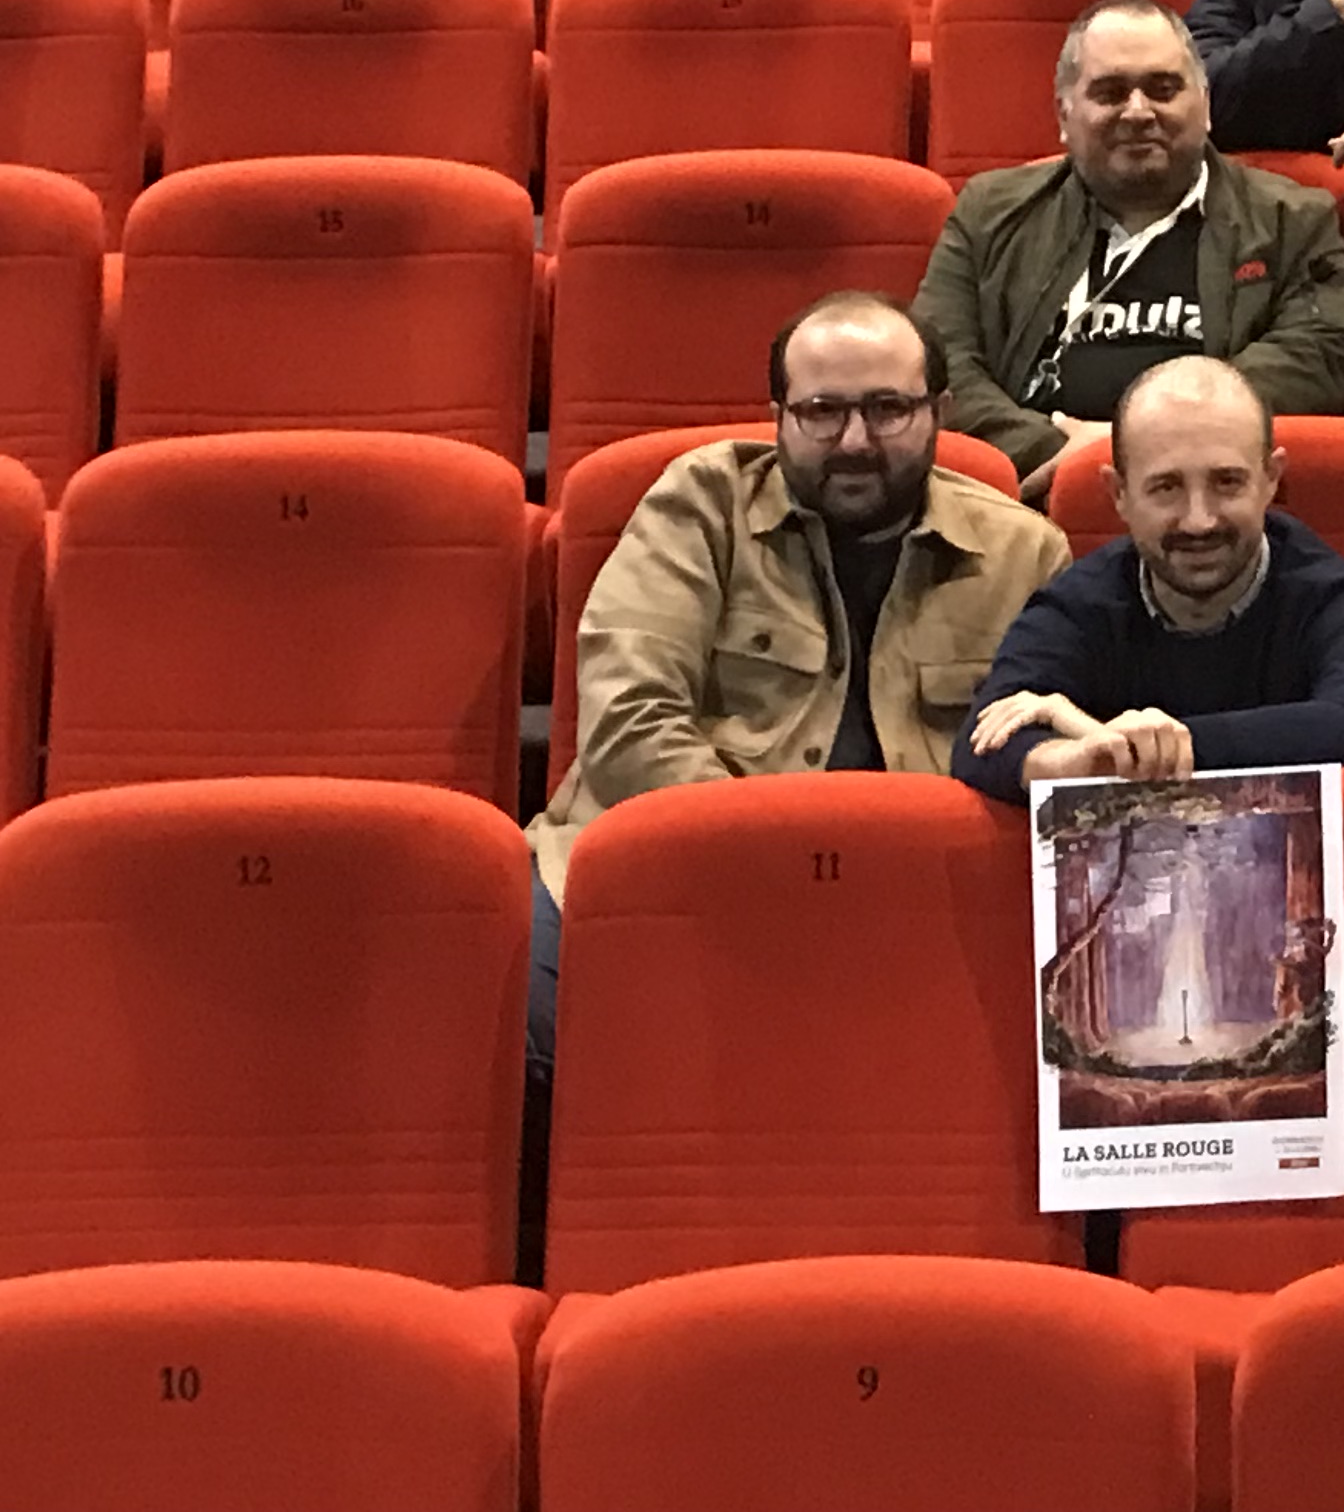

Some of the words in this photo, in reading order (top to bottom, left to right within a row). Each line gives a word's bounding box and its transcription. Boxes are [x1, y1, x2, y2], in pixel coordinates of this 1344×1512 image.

[318, 209, 343, 232] 15
[745, 202, 770, 224] 14
[280, 495, 309, 520] 14
[237, 855, 272, 885] 12
[811, 851, 840, 881] 11
[1063, 1146, 1089, 1162] LA
[1094, 1142, 1157, 1161] SALLE
[1162, 1139, 1234, 1157] ROUGE
[160, 1365, 202, 1402] 10
[856, 1365, 880, 1401] 9
